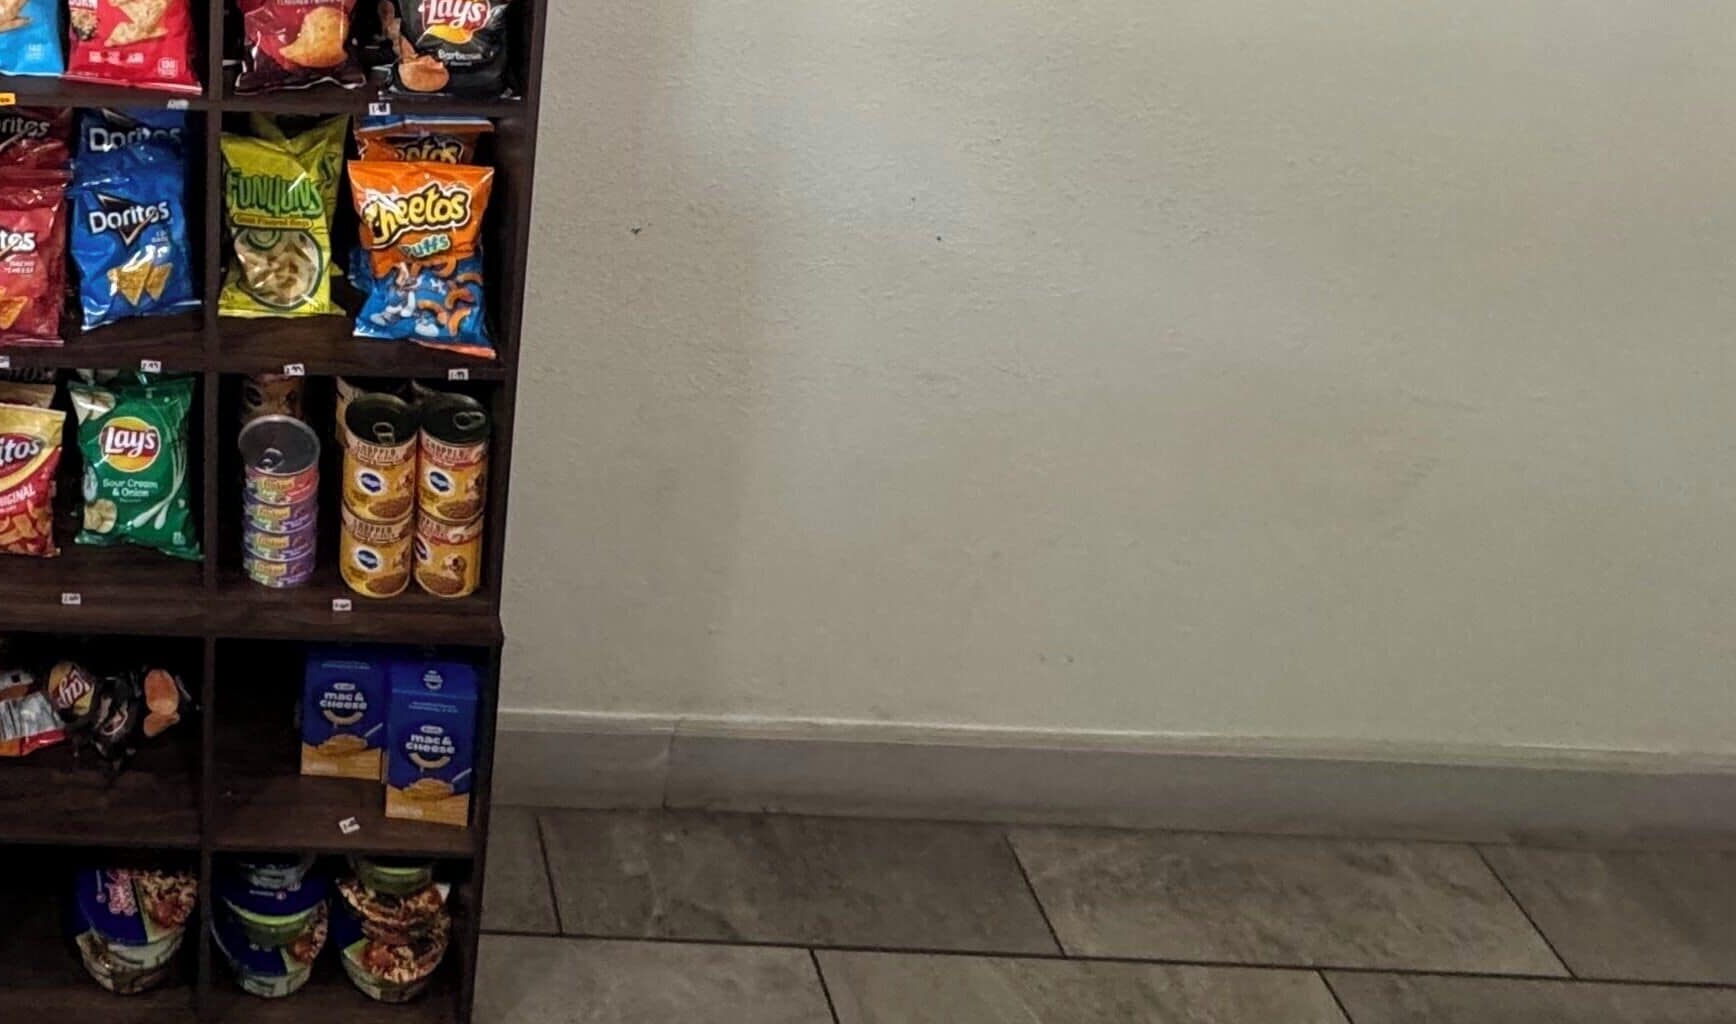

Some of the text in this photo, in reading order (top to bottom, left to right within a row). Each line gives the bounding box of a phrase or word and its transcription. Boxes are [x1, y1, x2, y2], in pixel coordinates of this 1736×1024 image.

[437, 49, 483, 62] Barbecue
[89, 127, 181, 152] Doritos
[226, 166, 323, 218] FUNYUNS
[89, 200, 170, 234] Doritos
[363, 182, 470, 244] Cheetos
[401, 232, 450, 258] Puffs
[105, 426, 158, 456] Lay's
[102, 478, 158, 489] Sour Cream
[121, 488, 149, 498] Onion
[323, 691, 364, 702] mac &
[319, 699, 368, 711] cheese
[410, 734, 452, 746] mac &
[405, 741, 455, 754] cheese
